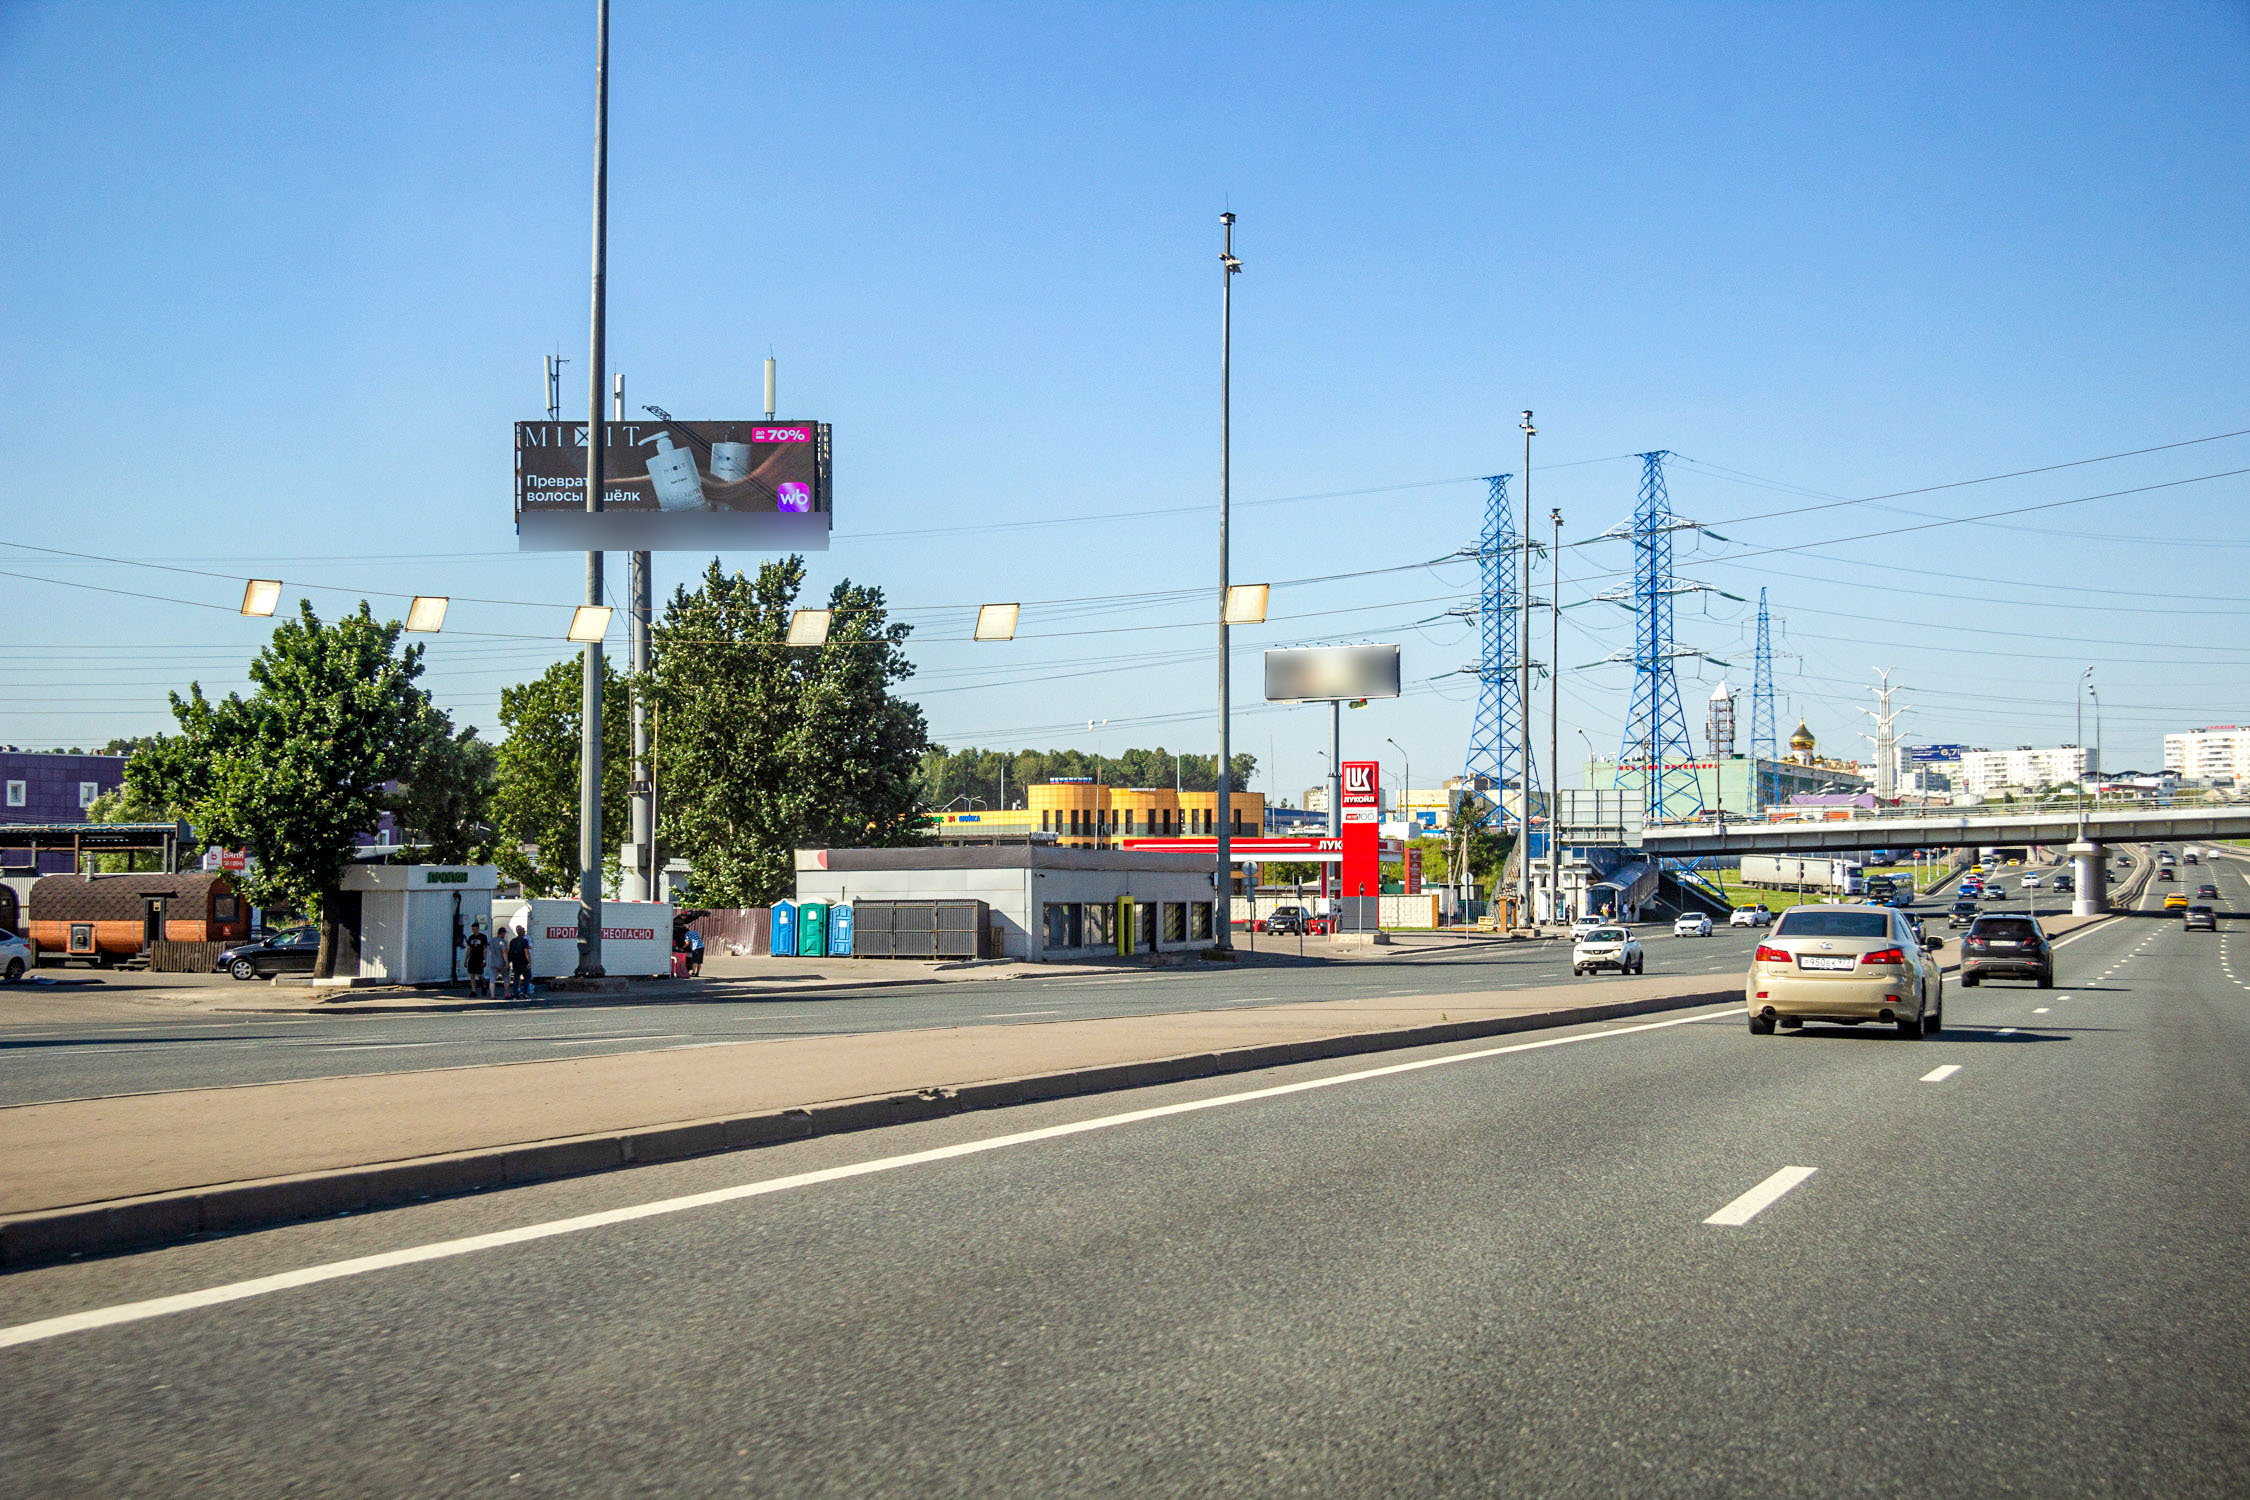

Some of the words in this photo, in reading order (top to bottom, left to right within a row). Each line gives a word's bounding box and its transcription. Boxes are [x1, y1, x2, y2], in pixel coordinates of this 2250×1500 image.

[526, 475, 588, 488] Преврат
[526, 491, 584, 502] волосы
[780, 488, 809, 506] wb
[1343, 795, 1375, 803] ЛУКОЙЛ
[1318, 840, 1342, 851] ЛУК
[601, 928, 652, 939] НЕОПАСНО
